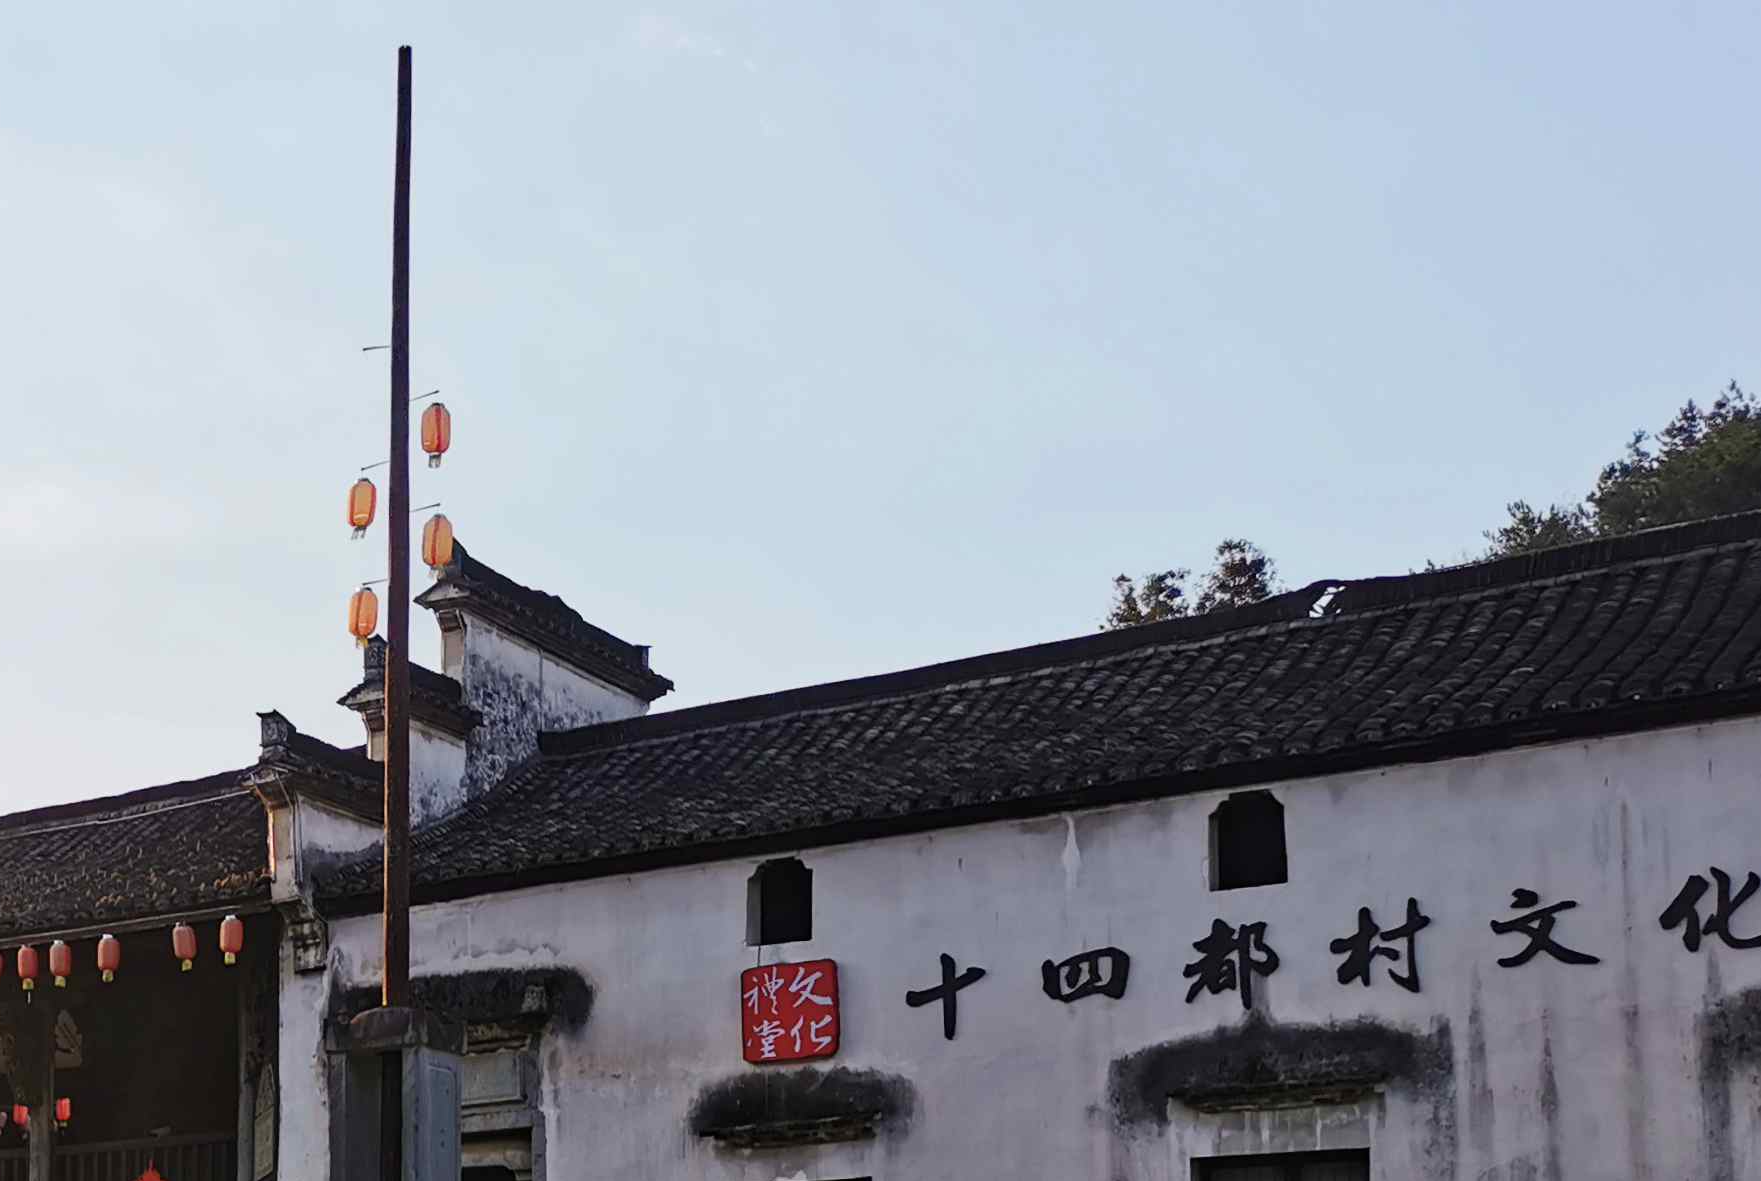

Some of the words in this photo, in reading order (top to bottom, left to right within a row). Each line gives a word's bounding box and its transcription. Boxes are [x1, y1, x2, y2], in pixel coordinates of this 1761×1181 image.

[904, 866, 1761, 1040] 十四都村文化
